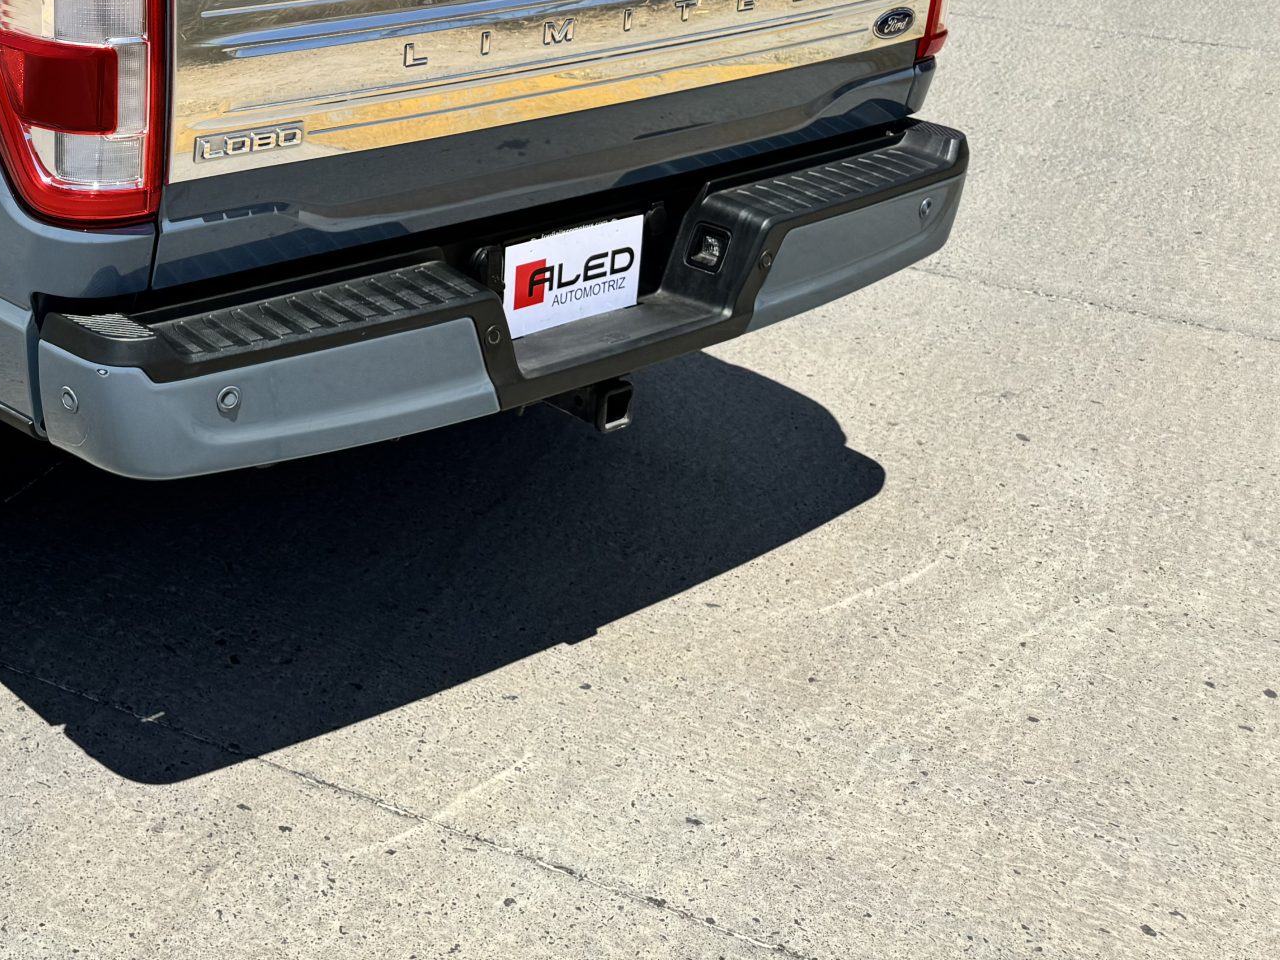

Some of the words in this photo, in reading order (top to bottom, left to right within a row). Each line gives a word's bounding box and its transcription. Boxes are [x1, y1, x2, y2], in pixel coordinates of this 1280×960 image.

[201, 127, 304, 160] LOBO
[528, 246, 635, 298] ALED
[551, 276, 626, 307] AUTOMOTRIZ
